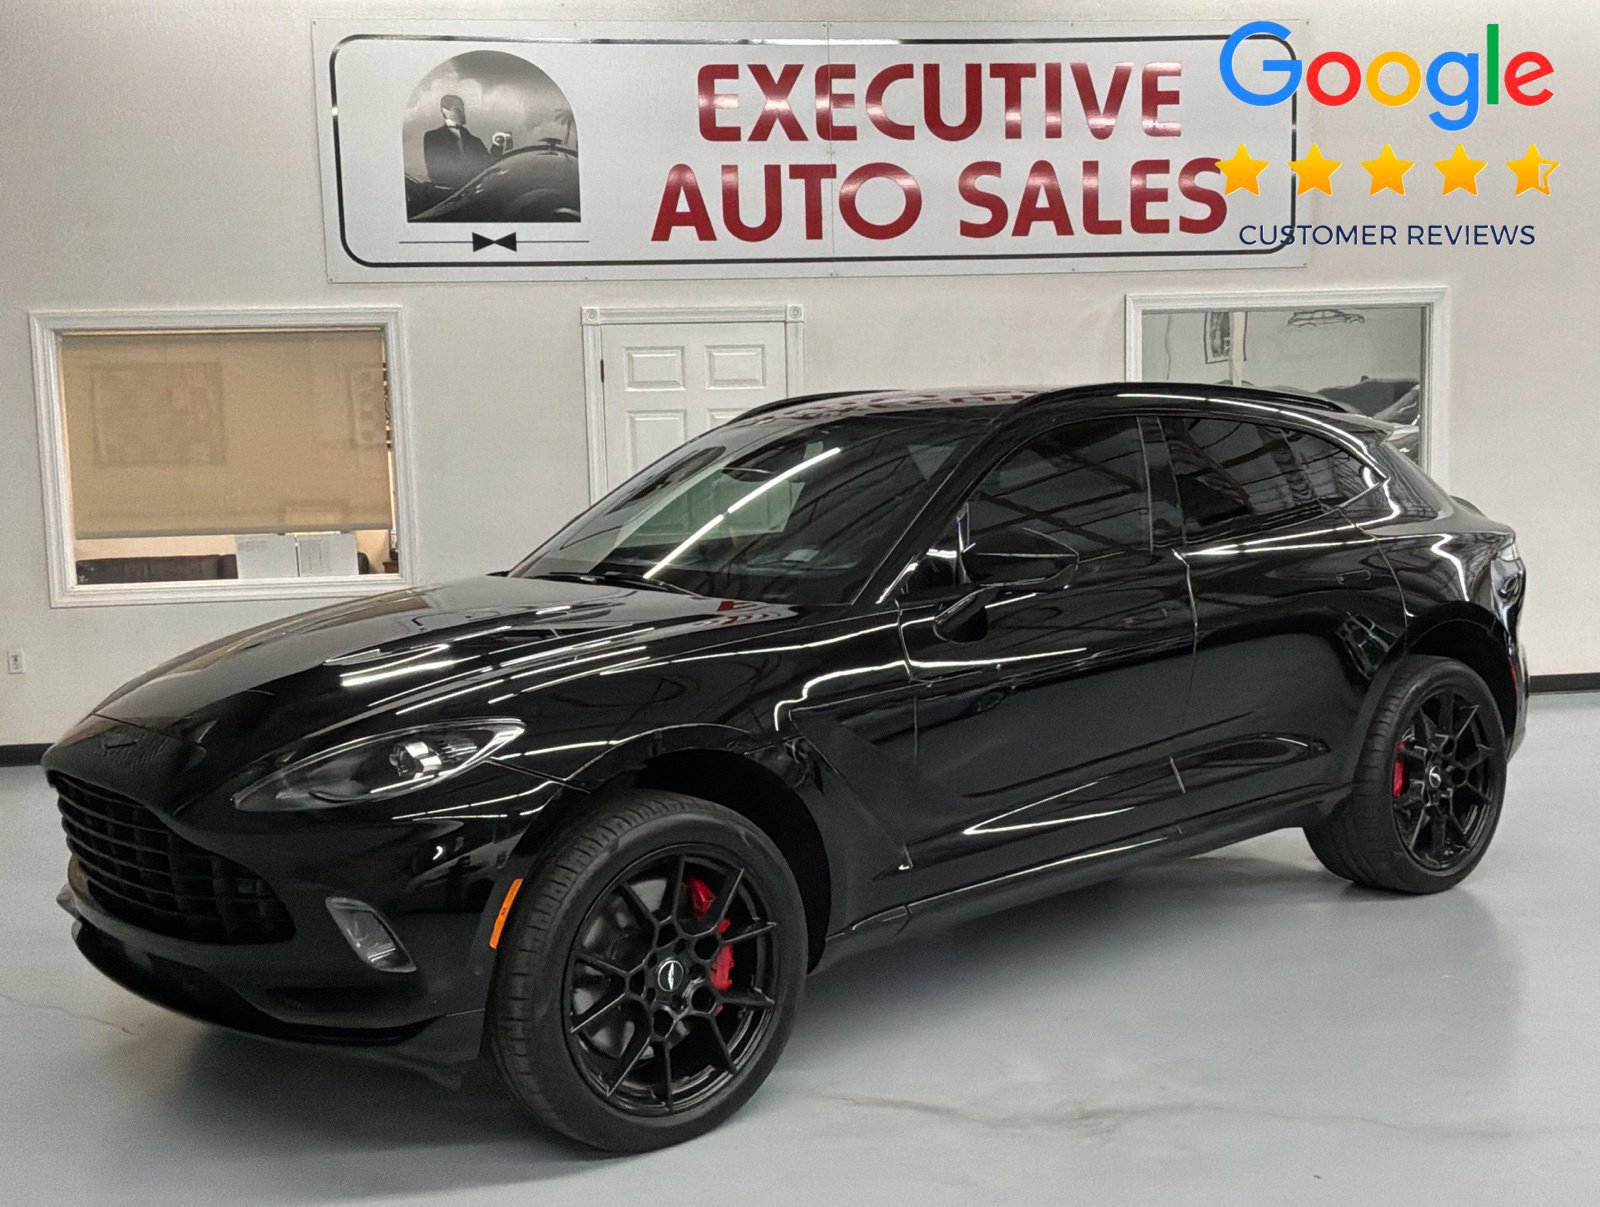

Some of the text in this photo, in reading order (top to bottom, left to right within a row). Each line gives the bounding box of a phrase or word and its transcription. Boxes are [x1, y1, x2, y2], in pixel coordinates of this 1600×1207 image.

[697, 61, 1183, 142] EXECUTIVE
[651, 158, 1228, 243] AUTO SALES
